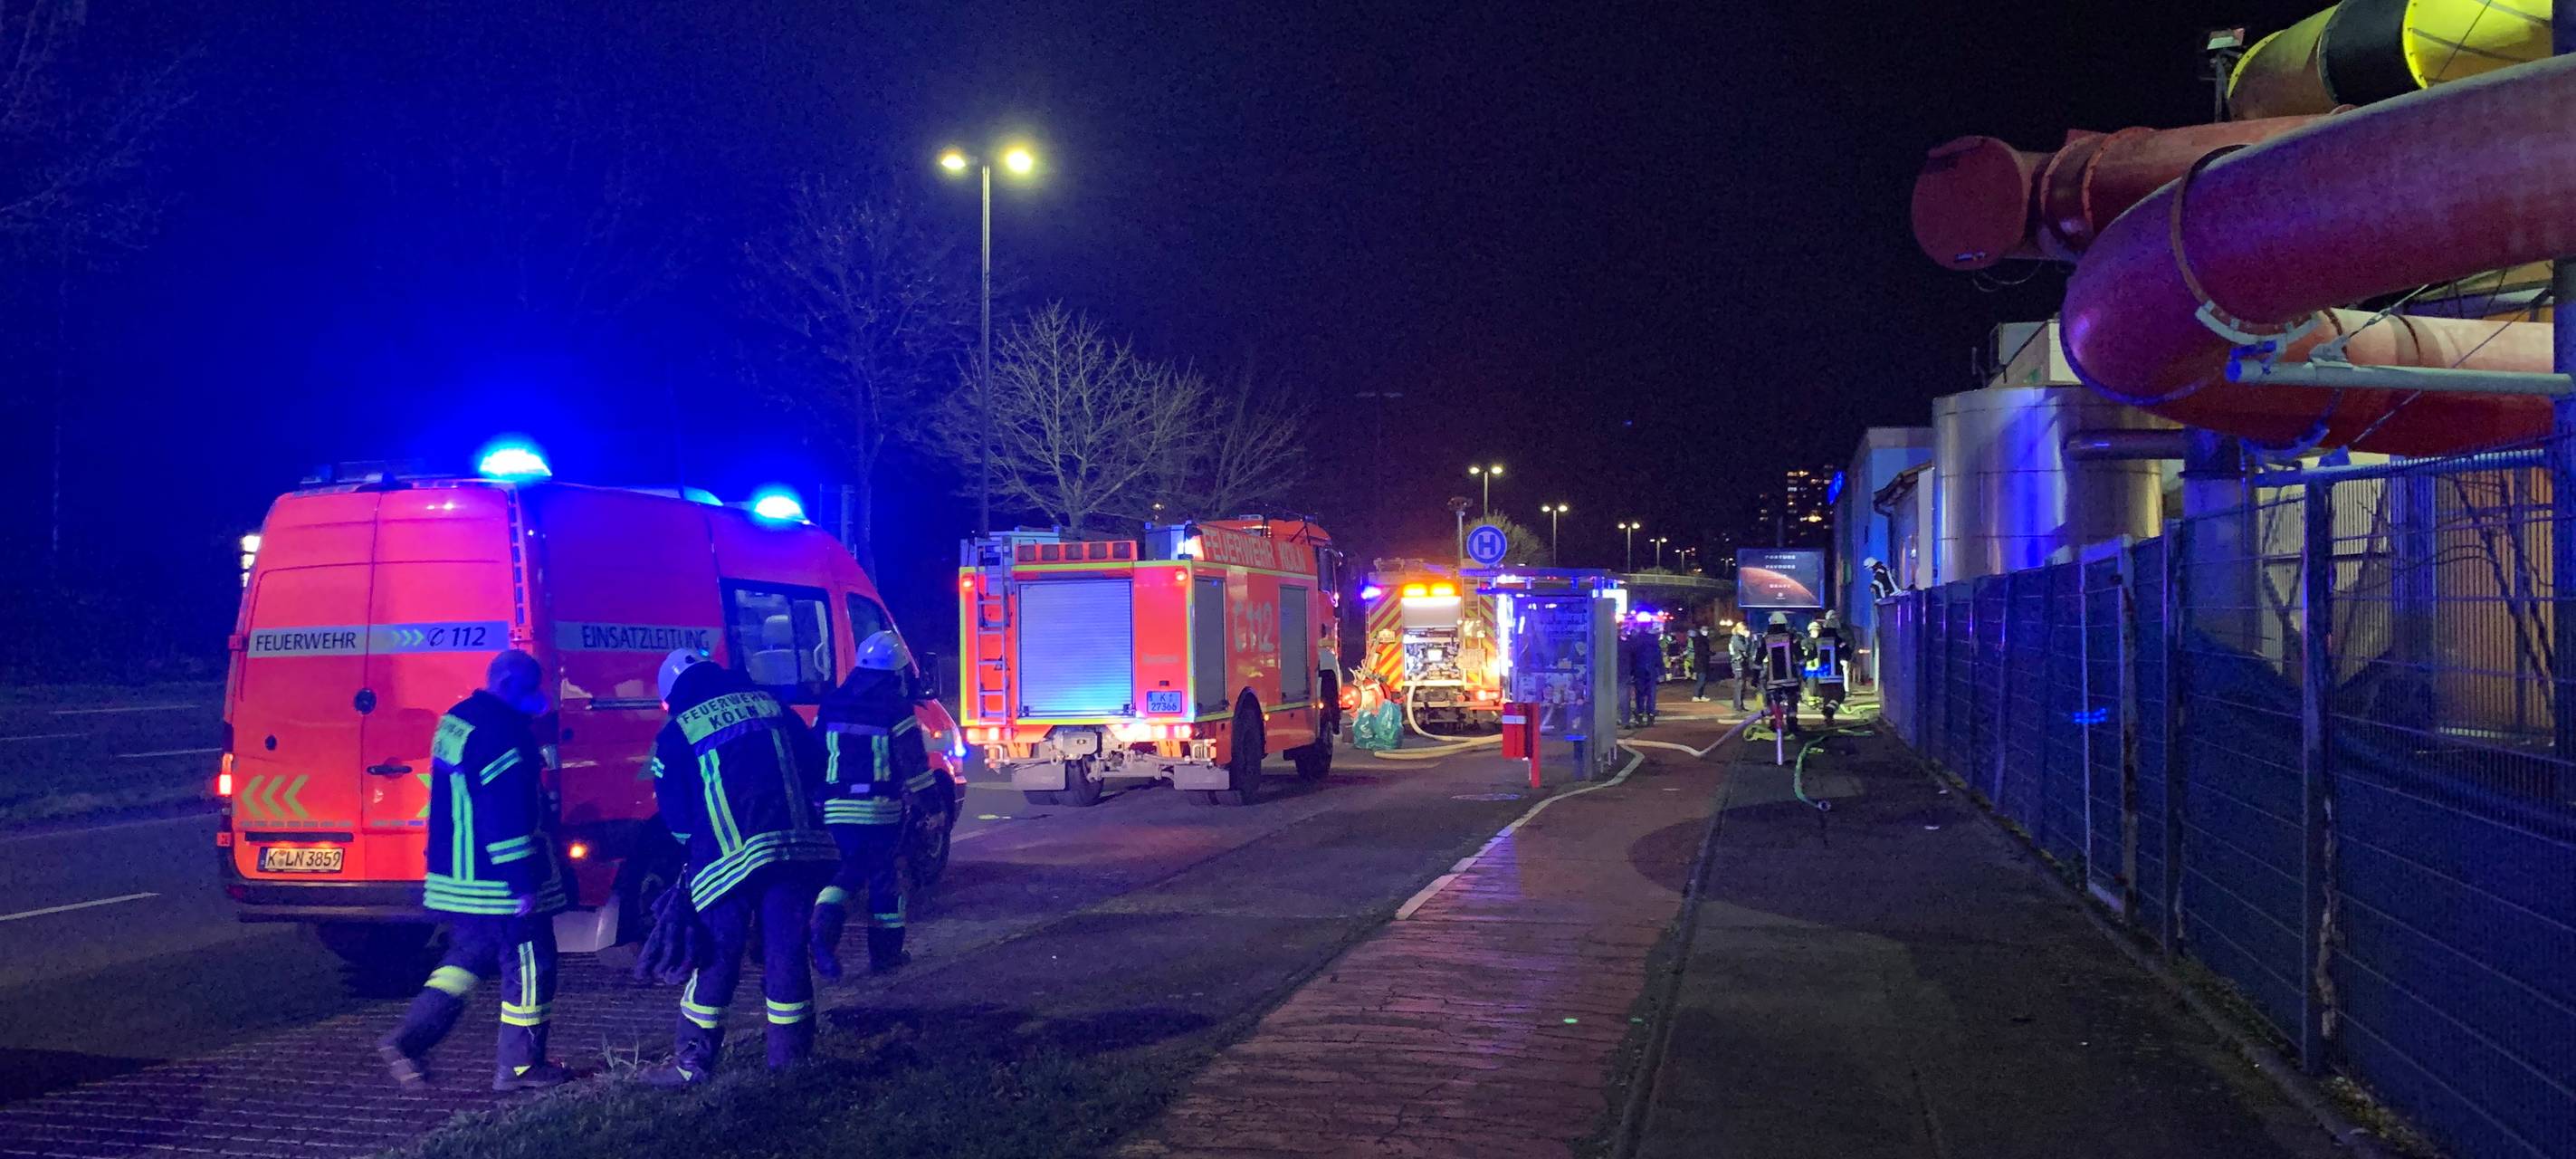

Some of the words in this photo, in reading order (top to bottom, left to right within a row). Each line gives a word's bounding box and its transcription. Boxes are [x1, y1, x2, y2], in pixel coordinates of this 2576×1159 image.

[1202, 528, 1276, 569] FEUERWEHR
[1477, 534, 1496, 555] H
[451, 627, 486, 647] 112
[582, 625, 709, 649] EINSATZLEITUNG
[1246, 600, 1275, 653] 112
[256, 632, 356, 651] FEUERWEHR
[1159, 694, 1166, 702] K
[709, 705, 759, 730] KÖLN
[267, 851, 279, 867] K
[286, 851, 304, 867] LN
[306, 850, 341, 867] 3859
